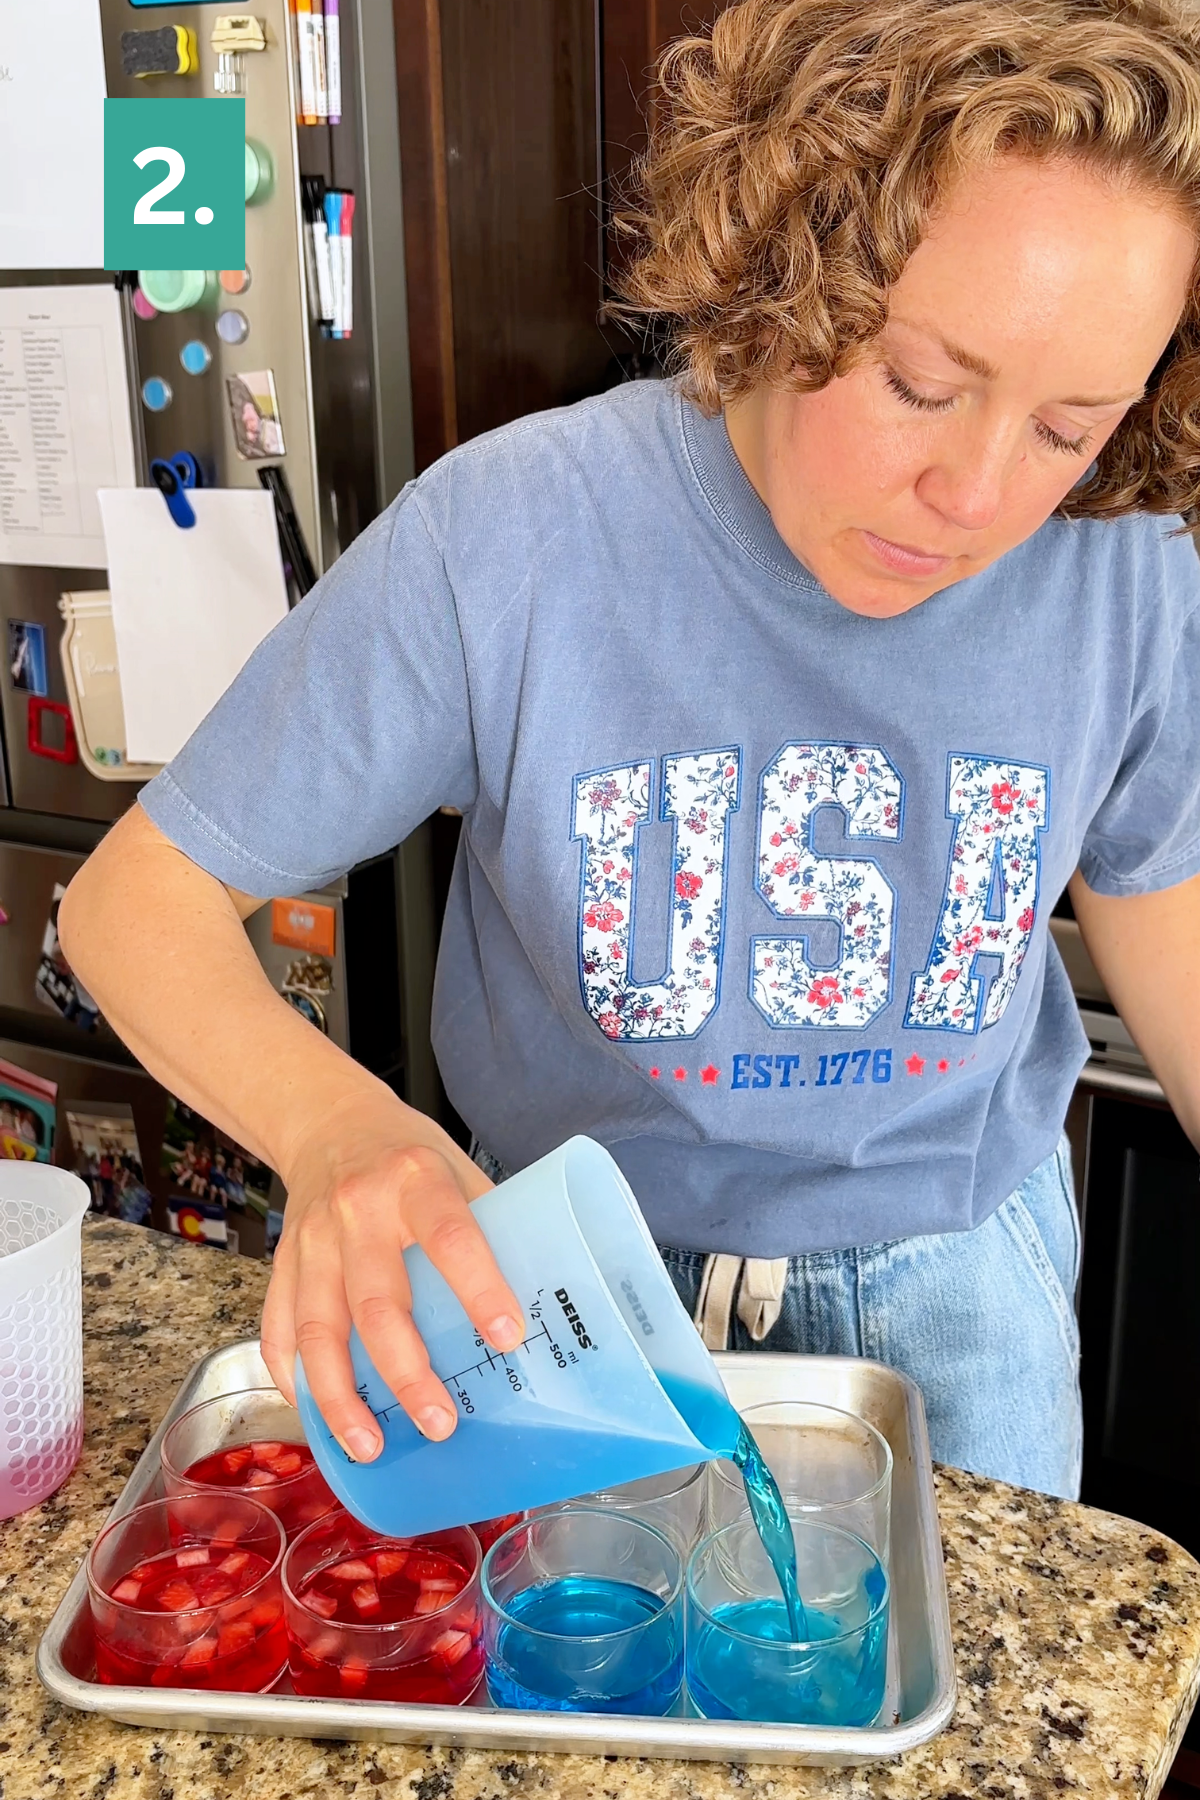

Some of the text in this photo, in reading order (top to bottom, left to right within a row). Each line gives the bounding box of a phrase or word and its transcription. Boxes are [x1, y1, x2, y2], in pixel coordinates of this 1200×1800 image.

[569, 740, 1051, 1043] USA
[731, 1048, 894, 1090] EST. 1776
[529, 1300, 543, 1320] 1/2
[549, 1343, 567, 1369] 500
[566, 1350, 579, 1364] ml
[505, 1367, 522, 1393] 400
[457, 1389, 475, 1414] 300
